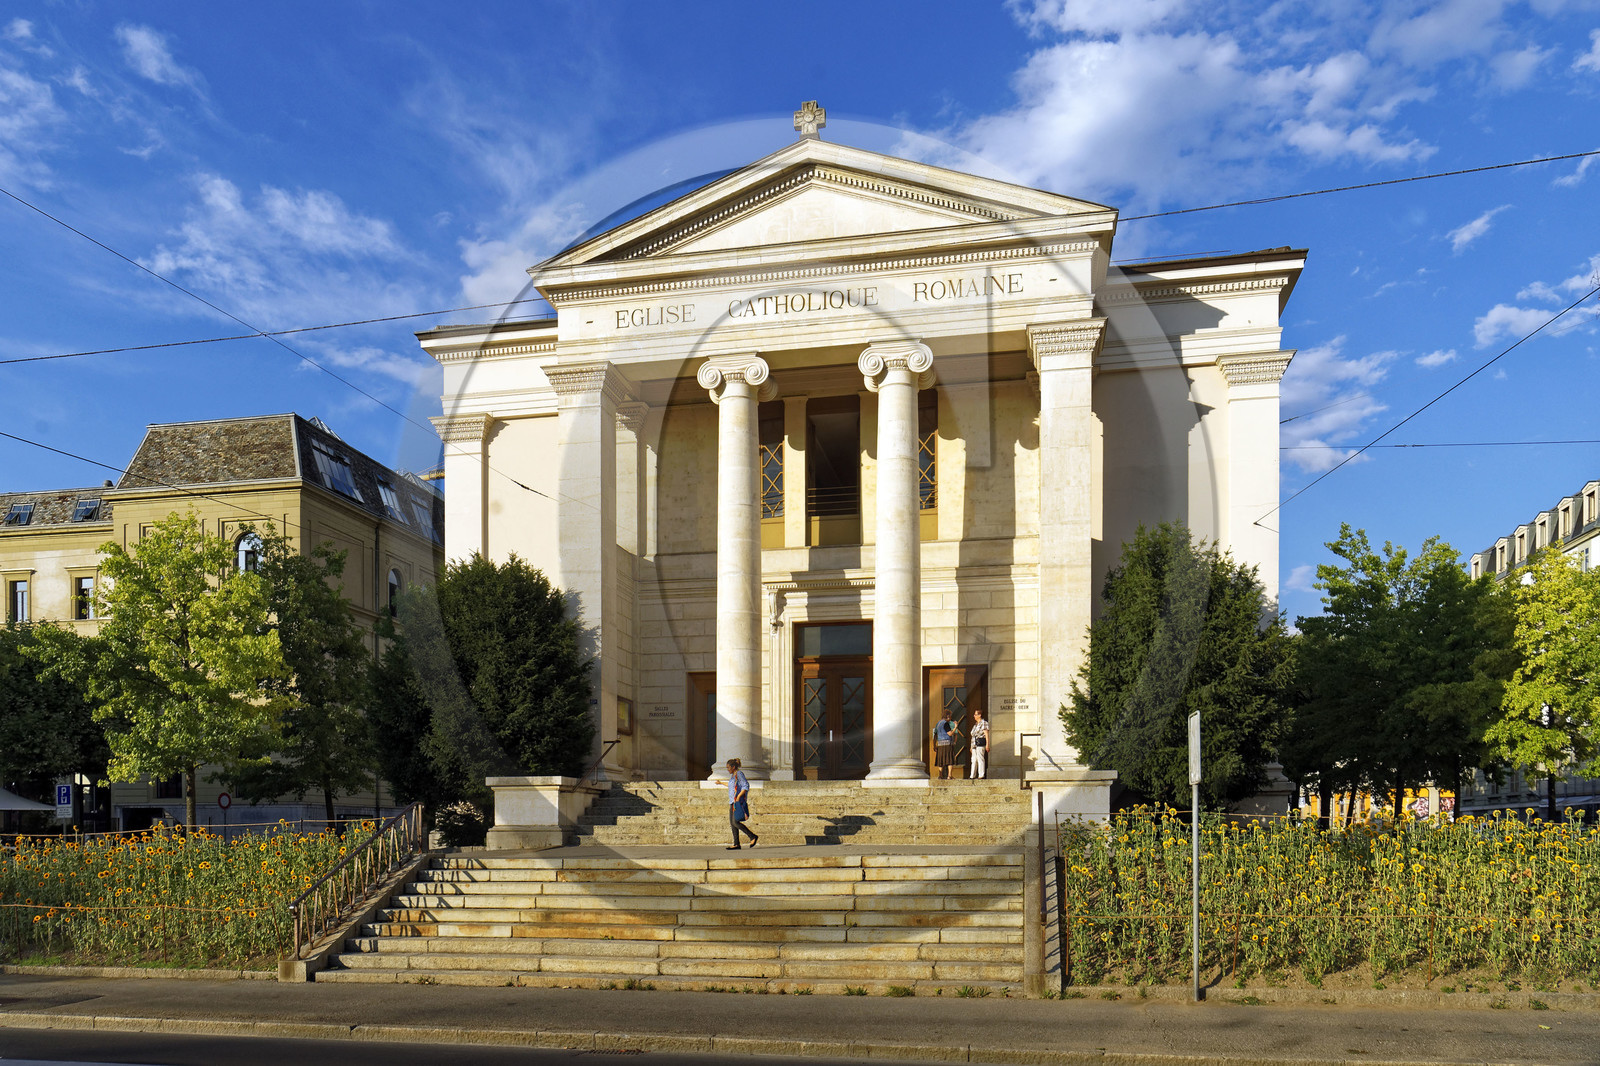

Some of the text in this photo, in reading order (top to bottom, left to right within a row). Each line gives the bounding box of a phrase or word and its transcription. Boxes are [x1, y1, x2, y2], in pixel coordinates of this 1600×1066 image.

[615, 273, 1024, 329] EGLISE CATHOLIQUE ROMAINE
[61, 787, 67, 797] P
